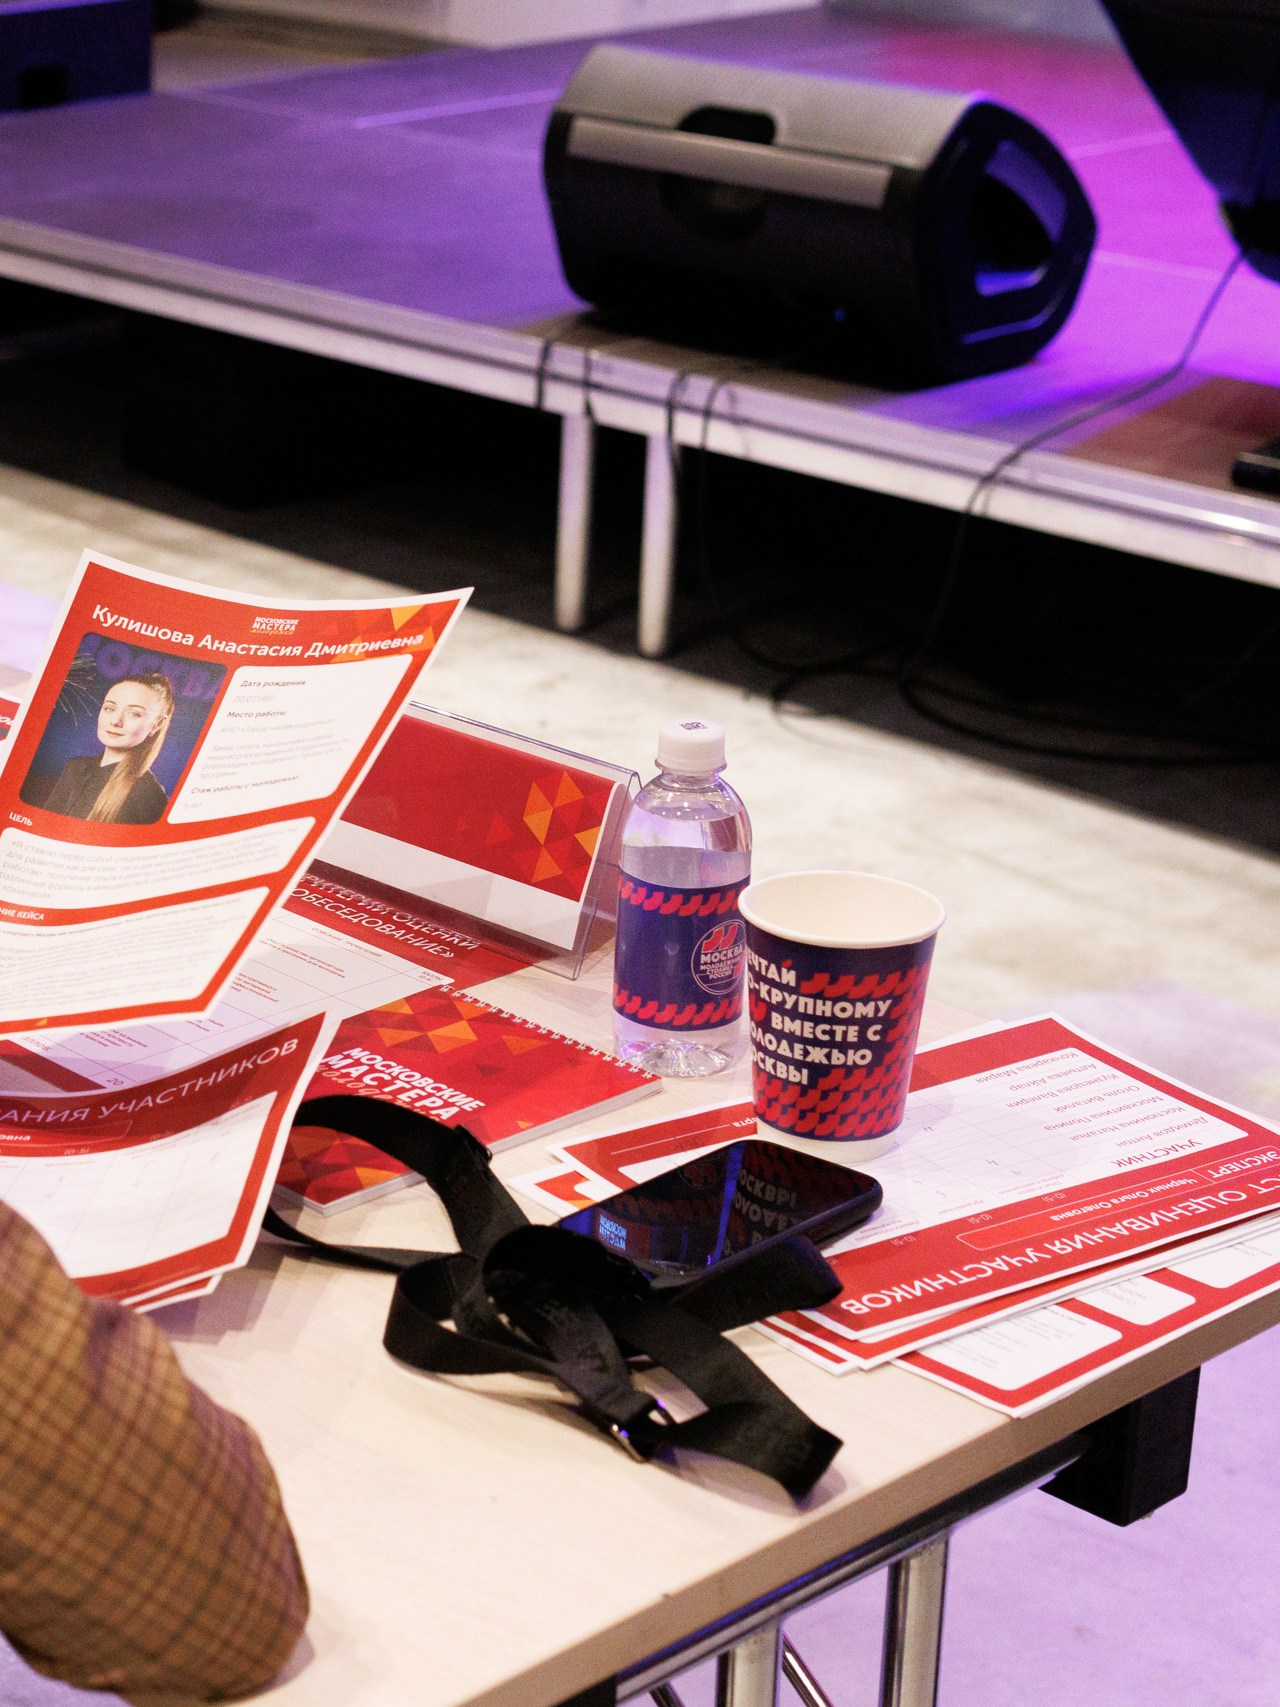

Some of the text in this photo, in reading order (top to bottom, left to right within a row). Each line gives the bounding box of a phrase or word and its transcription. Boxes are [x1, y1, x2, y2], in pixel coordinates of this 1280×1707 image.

[92, 604, 425, 659] Кулишова Анастасия Дмитриевна
[252, 622, 296, 631] МАСТЕРА
[255, 616, 299, 625] МОСКОВСКИЕ
[240, 679, 306, 688] Дата рождения
[227, 710, 287, 719] Место работы
[191, 787, 212, 795] Стаж
[213, 784, 243, 794] работы
[9, 812, 33, 826] ЦЕЛЬ
[24, 844, 57, 857] ставлю
[58, 852, 86, 862] перед
[86, 854, 113, 863] собой
[17, 909, 45, 921] КЕЙСА
[289, 887, 455, 958] ОБЕСЕДОВАНИЕ»
[700, 944, 743, 964] МОСКВА
[747, 948, 797, 987] ЕЧТАЙ
[747, 970, 893, 1019] О-КРУПНОМУ
[750, 1021, 873, 1066] ОЛОДЕЖЬЮ
[771, 1012, 883, 1042] ВМЕСТЕ С
[97, 1038, 300, 1120] УЧАСТНИКОВ
[342, 1047, 486, 1112] МОСКОВСКИЕ
[752, 1044, 809, 1085] ОСКВЫ
[975, 1051, 1079, 1084] Кочкарева Мария
[1009, 1062, 1097, 1092] Алтыева Айлар
[106, 1076, 125, 1087] 20
[320, 1054, 461, 1120] МАСТЕРА
[1006, 1073, 1120, 1108] Кузнецова Валерия
[1043, 1095, 1164, 1132] Москвитина Полина
[1053, 1085, 1140, 1113] Оголь Виталий
[1069, 1105, 1186, 1142] Костюнина Наталья
[1116, 1116, 1210, 1148] Демидов Антон
[1110, 1138, 1202, 1168] УЧАСТНИК
[1050, 1150, 1280, 1222] ЭКСПЕРТ Черных Ольга Олеговна
[1248, 1176, 1280, 1195] СТ
[891, 1192, 1067, 1246] (0-5) (0-5) (0-5)
[1043, 1189, 1248, 1255] ОЦЕНИВАНИЯ
[840, 1247, 1052, 1315] УЧАСТНИКОВ
